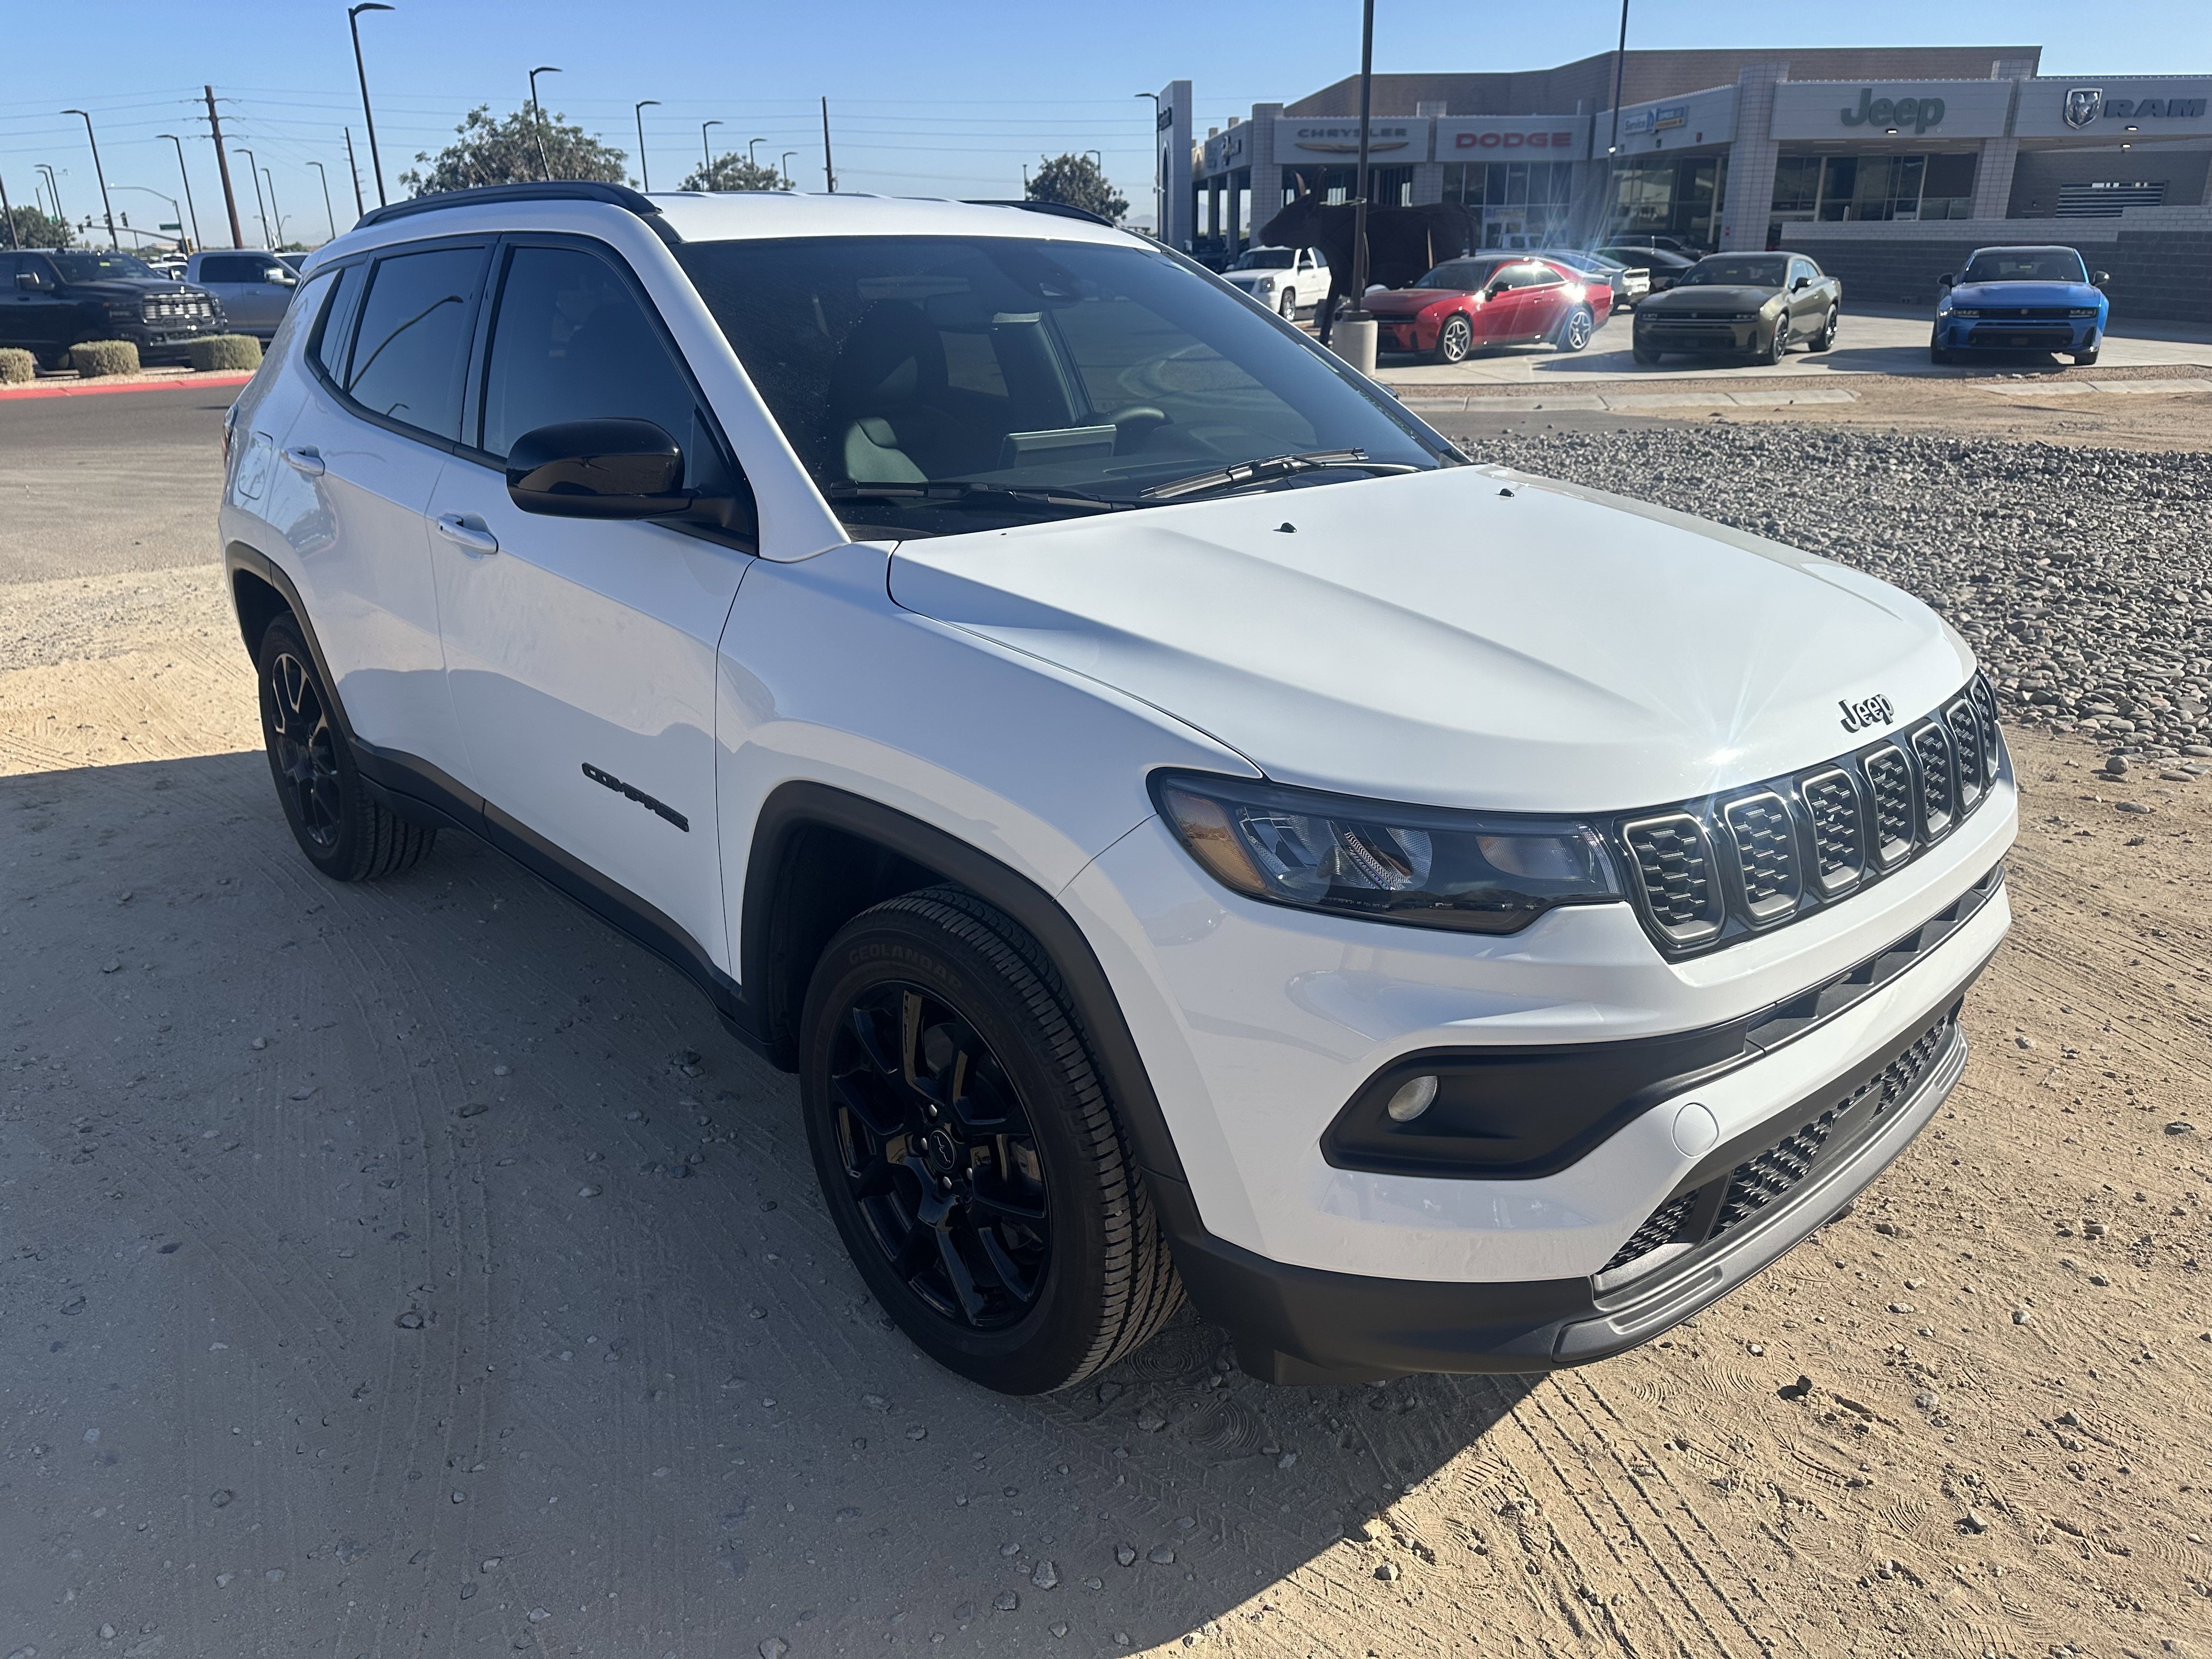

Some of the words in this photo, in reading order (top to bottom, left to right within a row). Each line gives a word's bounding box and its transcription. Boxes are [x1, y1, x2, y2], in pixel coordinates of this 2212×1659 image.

[1625, 118, 1645, 131] Service
[1840, 88, 1945, 134] Jeep
[2103, 99, 2207, 117] RAM
[1456, 132, 1572, 148] DODGE
[1838, 693, 1894, 733] Jeep
[582, 762, 690, 833] COMPASS
[848, 943, 964, 990] GEOLANDAR
